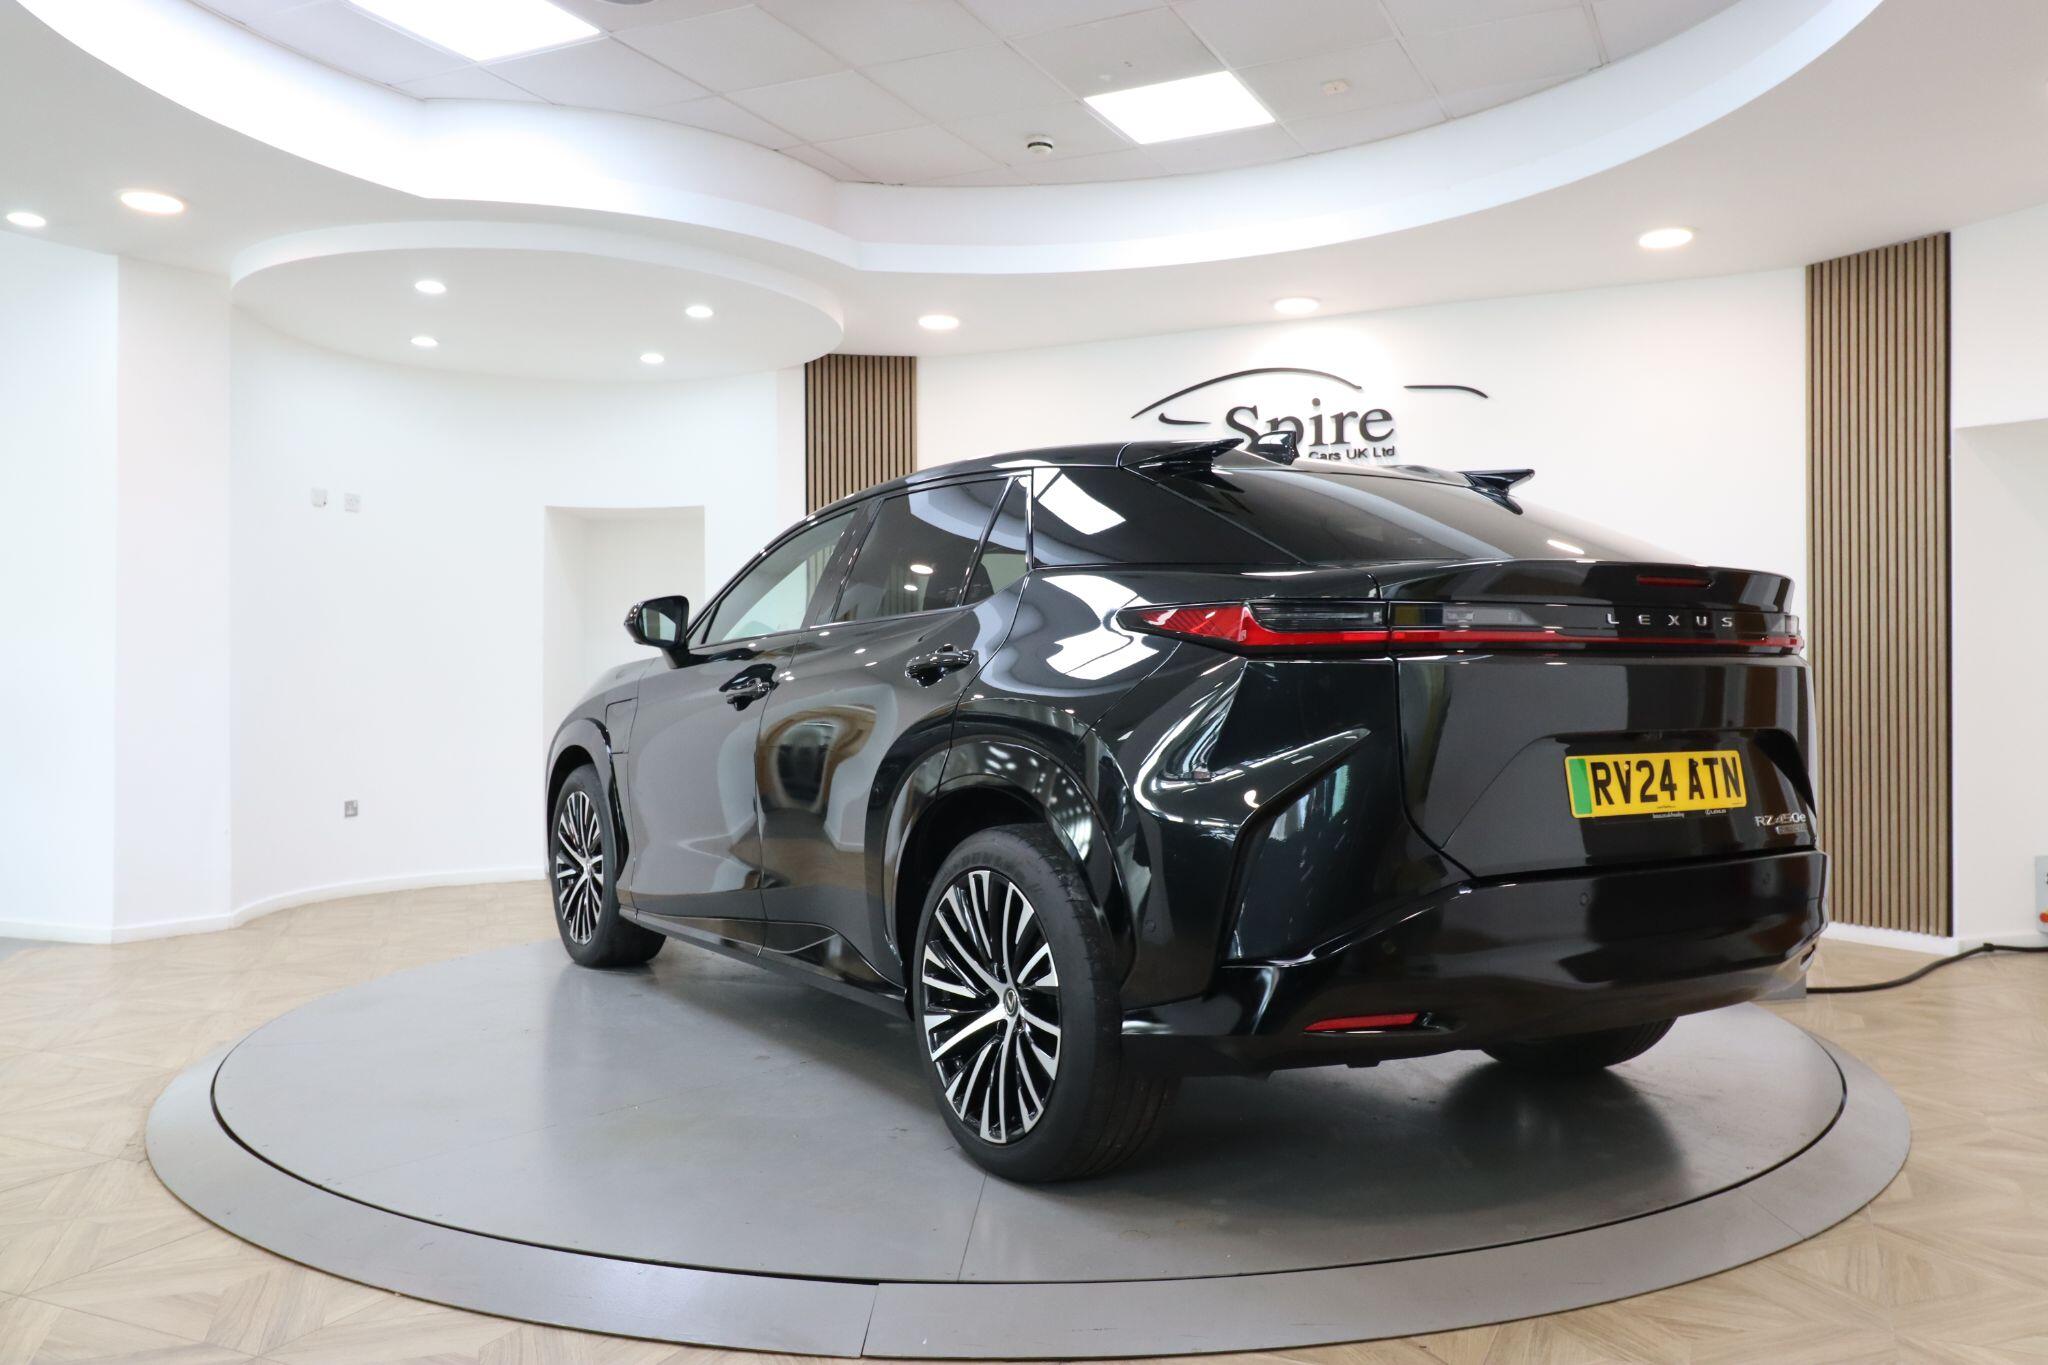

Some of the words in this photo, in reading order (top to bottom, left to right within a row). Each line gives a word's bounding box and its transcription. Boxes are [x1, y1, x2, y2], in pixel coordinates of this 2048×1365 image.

[1309, 450, 1342, 461] Cars
[1346, 448, 1369, 459] UK
[1373, 446, 1395, 458] Ltd
[1607, 613, 1736, 628] LEXUS
[1590, 759, 1677, 806] RV24
[1688, 757, 1742, 801] ATN
